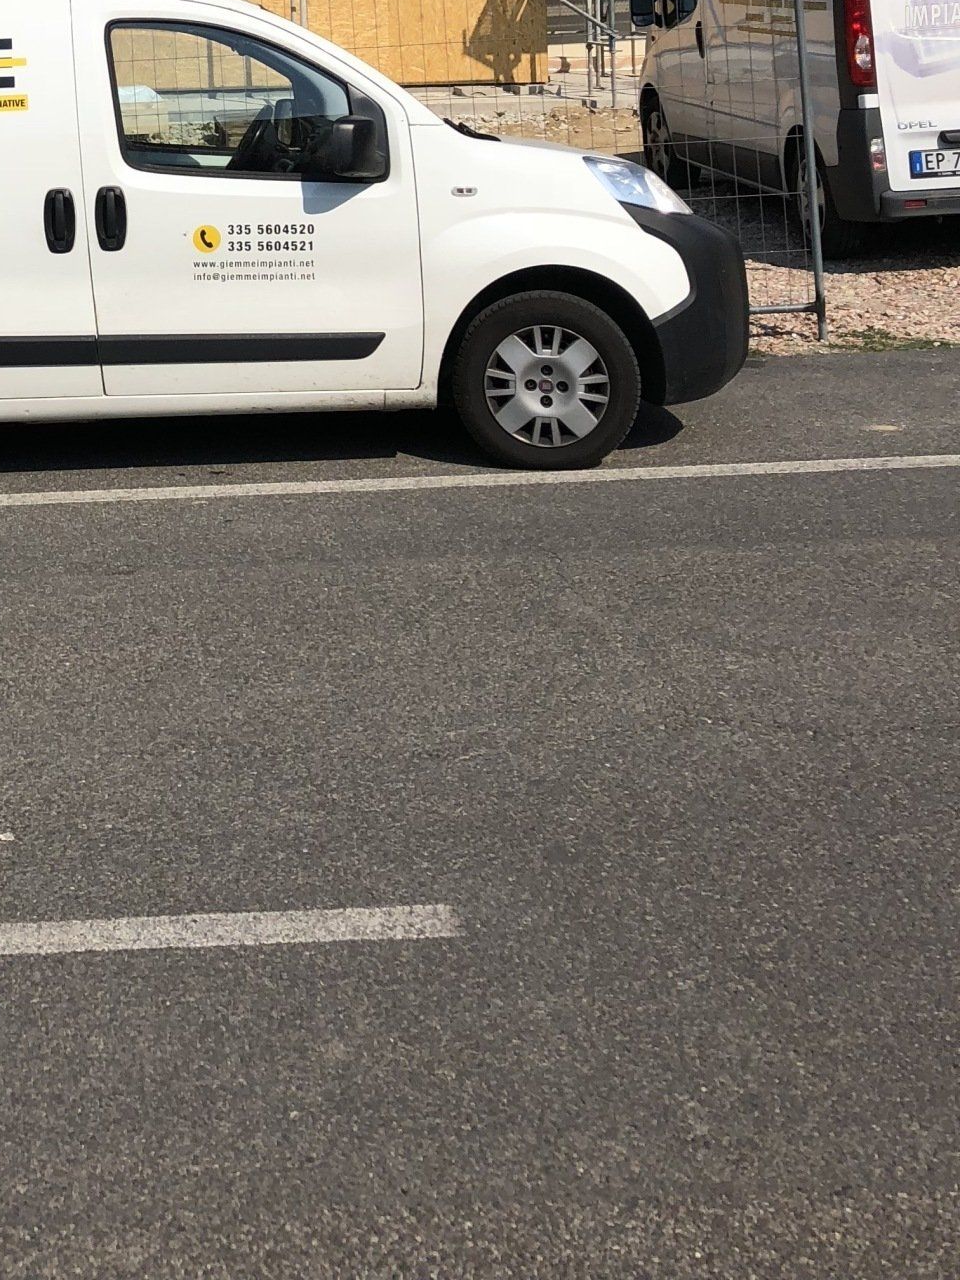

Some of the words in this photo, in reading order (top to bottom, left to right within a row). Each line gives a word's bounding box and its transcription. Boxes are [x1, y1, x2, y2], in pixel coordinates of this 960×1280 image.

[897, 121, 938, 130] OPEL
[925, 153, 945, 170] EP
[227, 224, 251, 235] 335
[257, 224, 315, 235] 5604520
[227, 241, 251, 252] 335
[257, 241, 314, 251] 5604521
[193, 259, 315, 270] www.giemmeimpianti.net
[193, 272, 316, 282] info@giemmeimpianti.net
